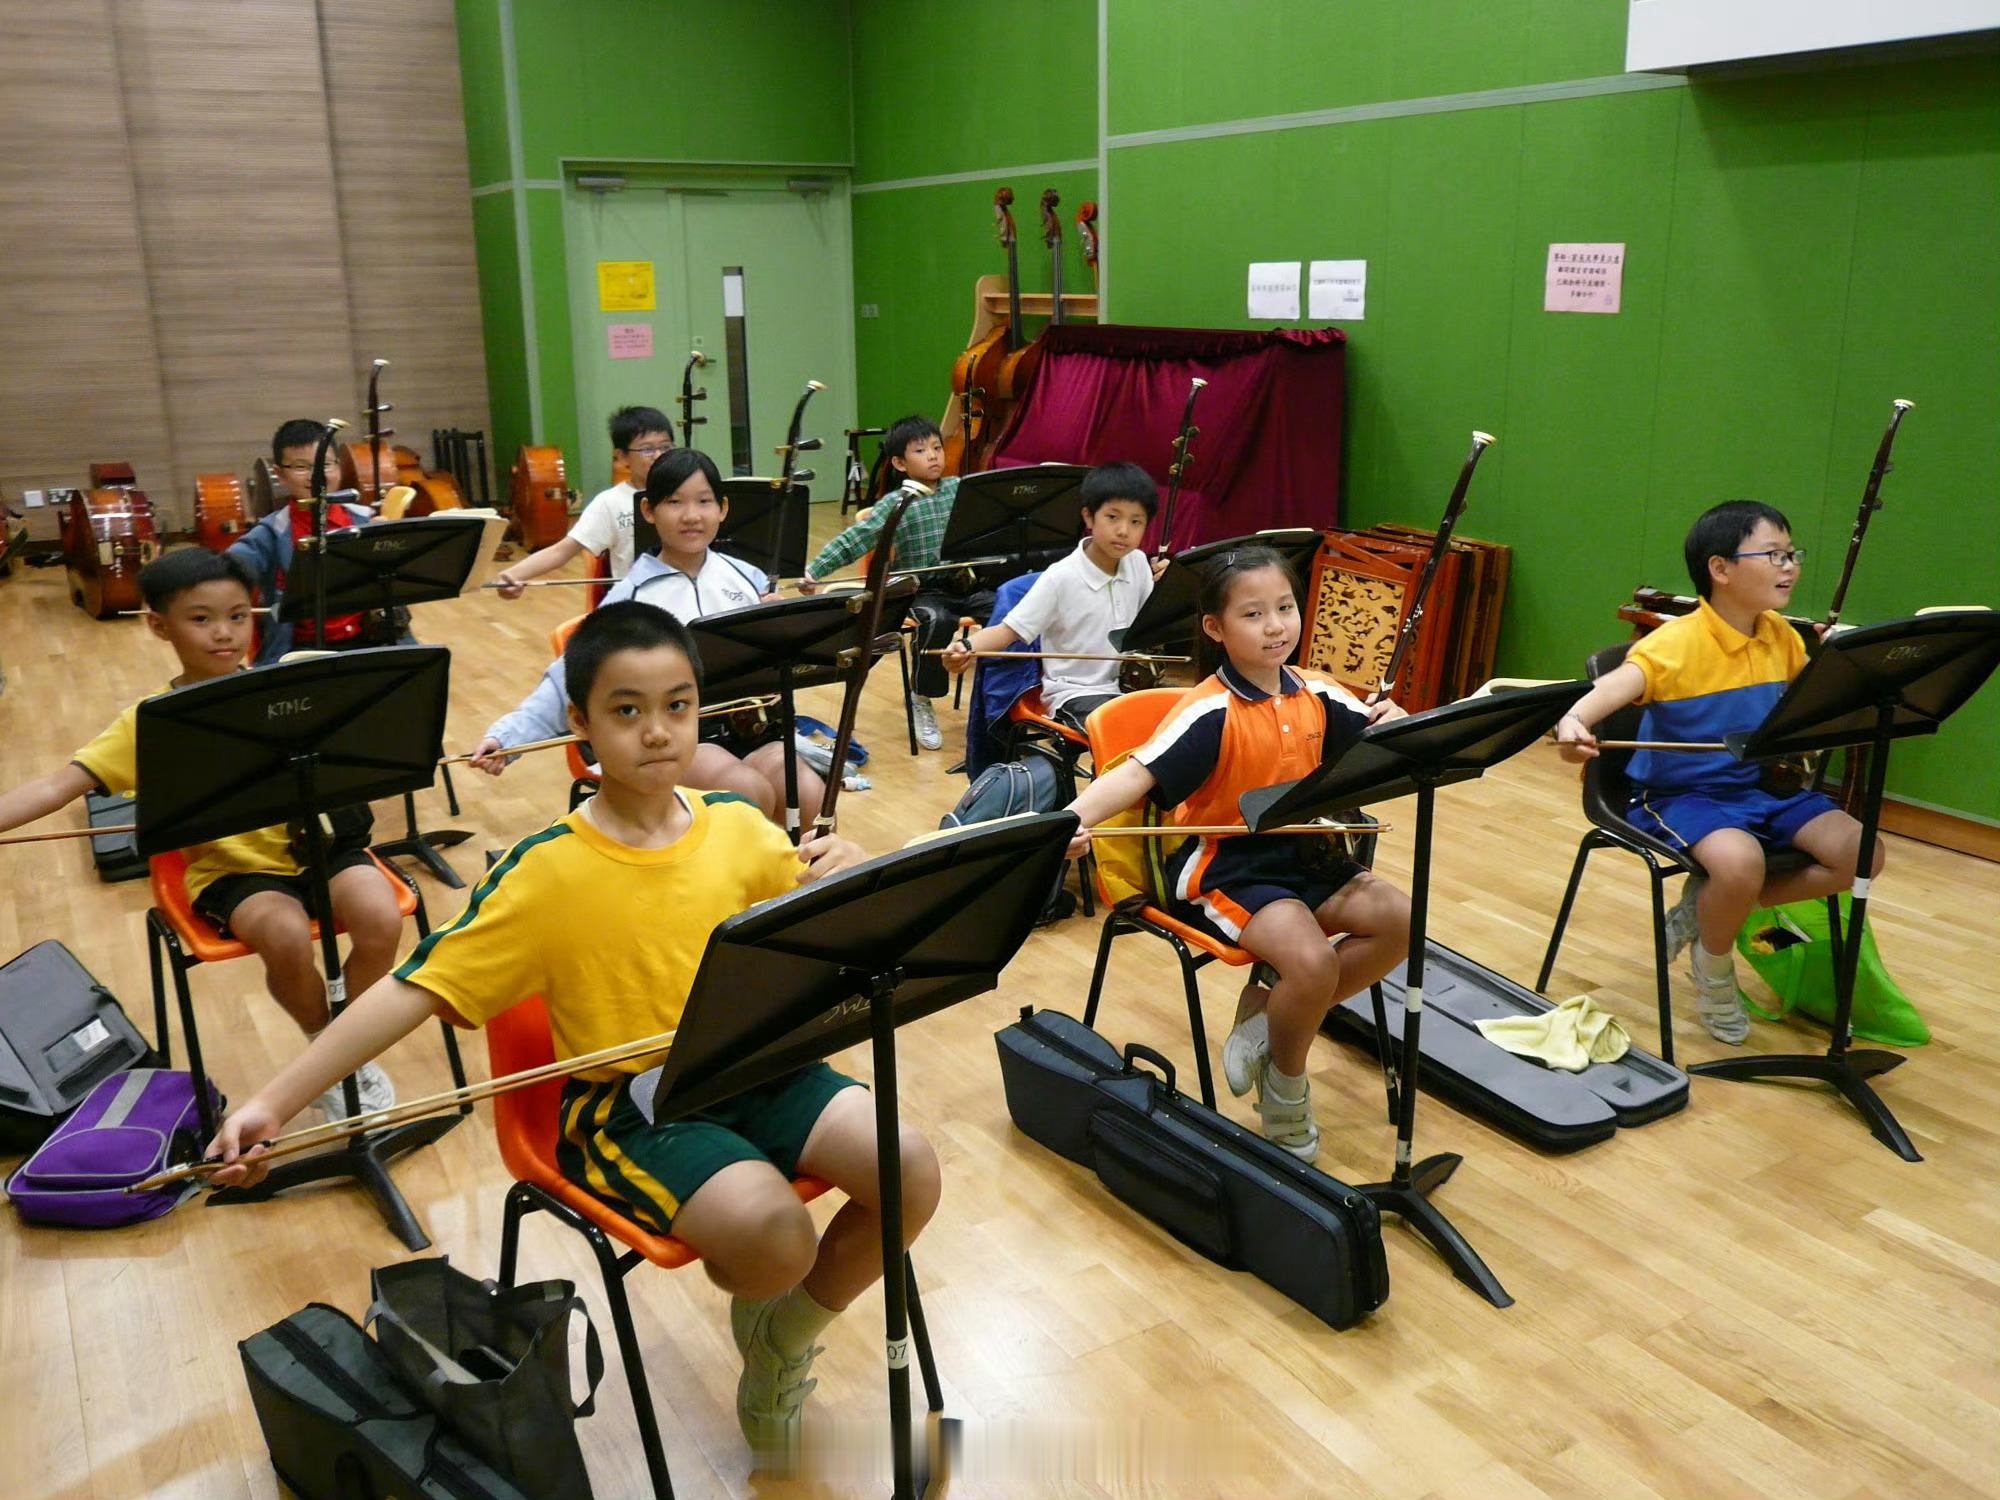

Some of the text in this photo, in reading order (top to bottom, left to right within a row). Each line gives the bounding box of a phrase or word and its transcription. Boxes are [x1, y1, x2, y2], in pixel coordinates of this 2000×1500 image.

[1012, 485, 1038, 496] KTMC
[1885, 644, 1925, 661] KTMC
[267, 697, 312, 719] KTMC
[887, 1343, 906, 1360] 07
